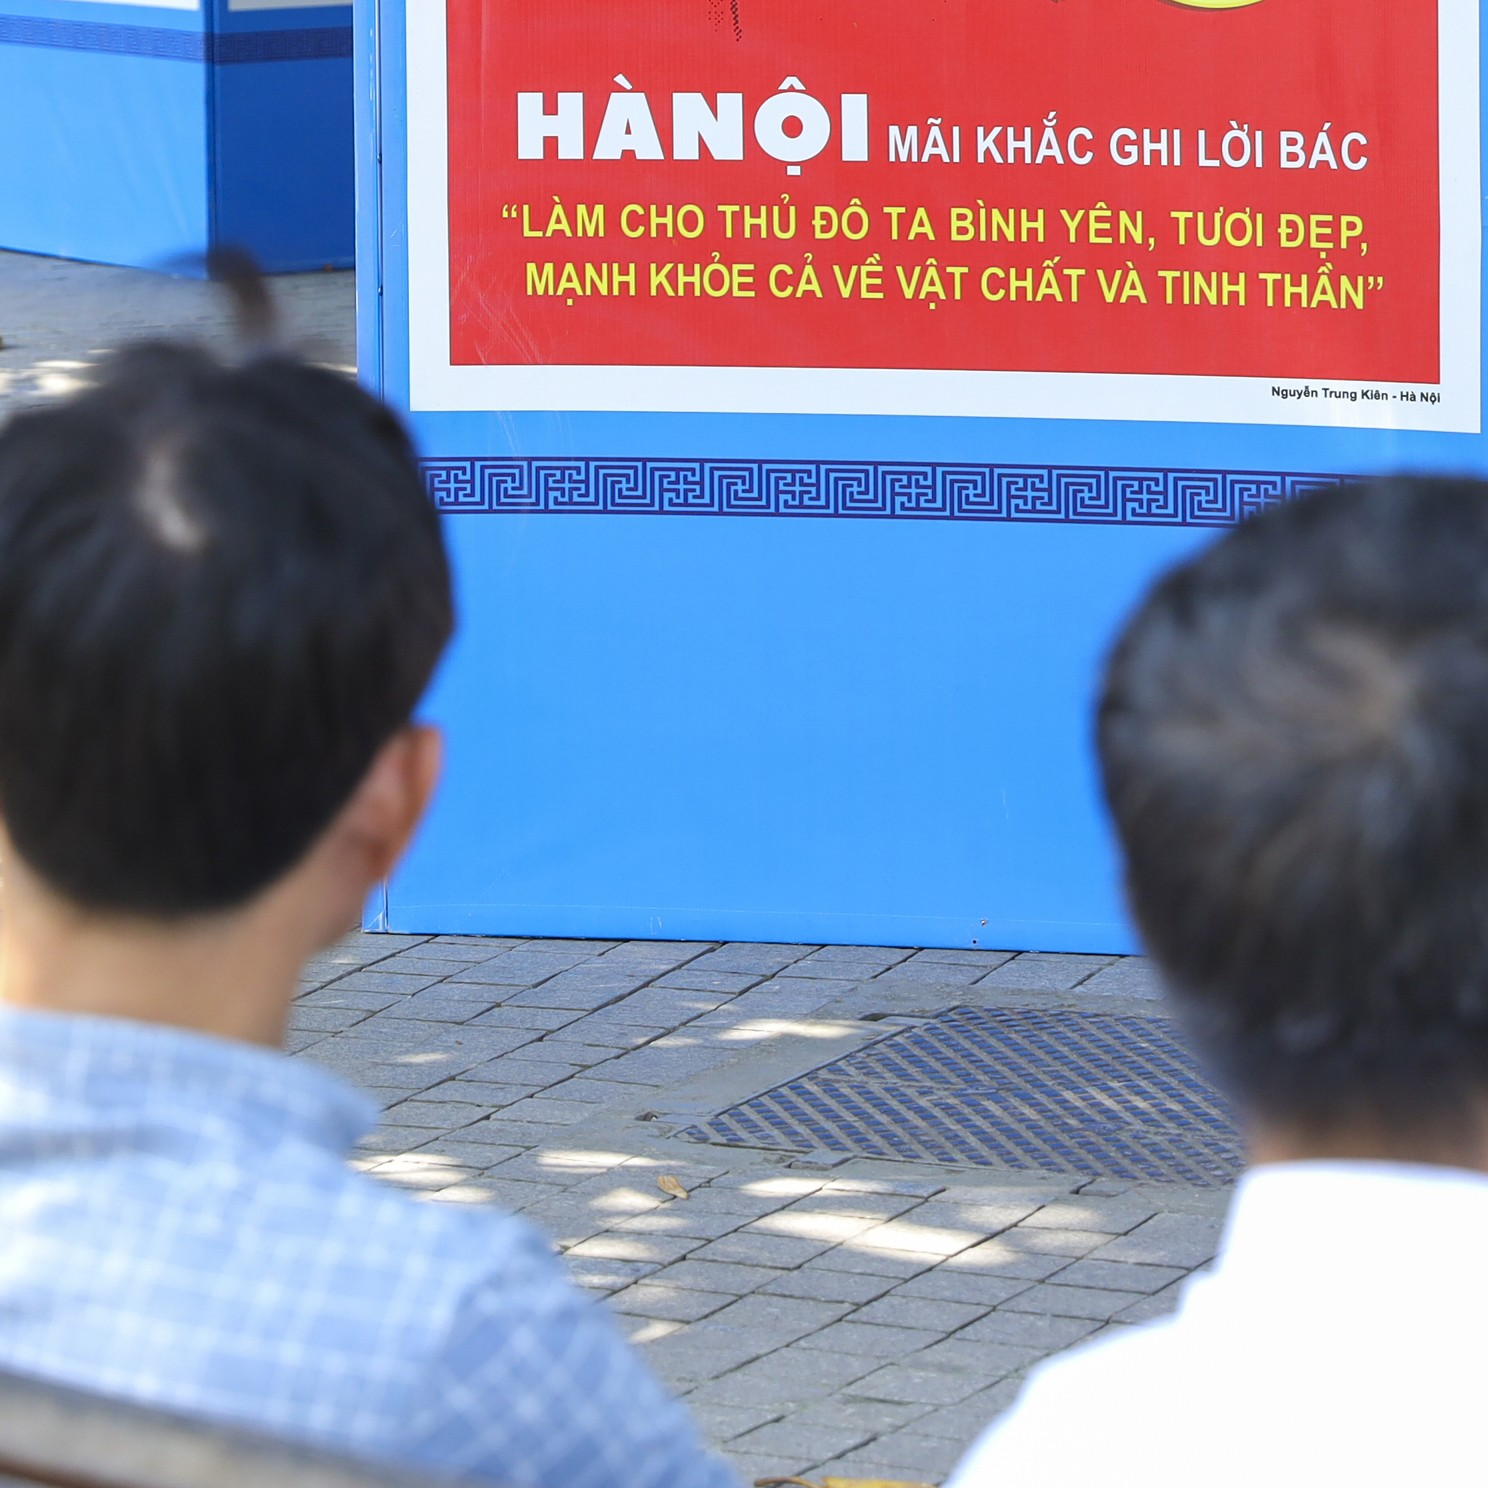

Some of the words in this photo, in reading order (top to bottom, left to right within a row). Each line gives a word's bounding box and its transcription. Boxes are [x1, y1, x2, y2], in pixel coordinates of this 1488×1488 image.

[516, 73, 869, 176] HÀNỘI
[887, 117, 960, 164] MÃI
[976, 111, 1094, 166] KHẮC
[1109, 127, 1182, 167] GHI
[1198, 120, 1263, 169] LỜI
[1279, 121, 1369, 171] BÁC
[502, 195, 605, 238] “LÀM
[620, 203, 705, 239] CHO
[717, 193, 797, 240] THỦ
[812, 198, 870, 241] ĐÔ
[882, 206, 936, 241] TA
[949, 199, 1045, 243] BÌNH
[1059, 201, 1156, 252] YÊN,
[1170, 207, 1263, 247] TƯƠI
[1277, 213, 1369, 260] ĐẸP,
[526, 261, 636, 306] MẠNH
[649, 251, 756, 298] KHỎE
[768, 252, 823, 299] CẢ
[832, 253, 884, 300] VỀ
[895, 257, 969, 310] VẬT
[979, 256, 1086, 303] CHẤT
[1095, 261, 1147, 304] VÀ
[1157, 270, 1247, 307] TINH
[1258, 262, 1384, 310] THẦN”
[1271, 385, 1318, 400] Nguyễn
[1322, 387, 1357, 402] Trung
[1361, 389, 1389, 401] Kiên
[1400, 391, 1416, 403] Hà
[1420, 392, 1441, 405] Nội
